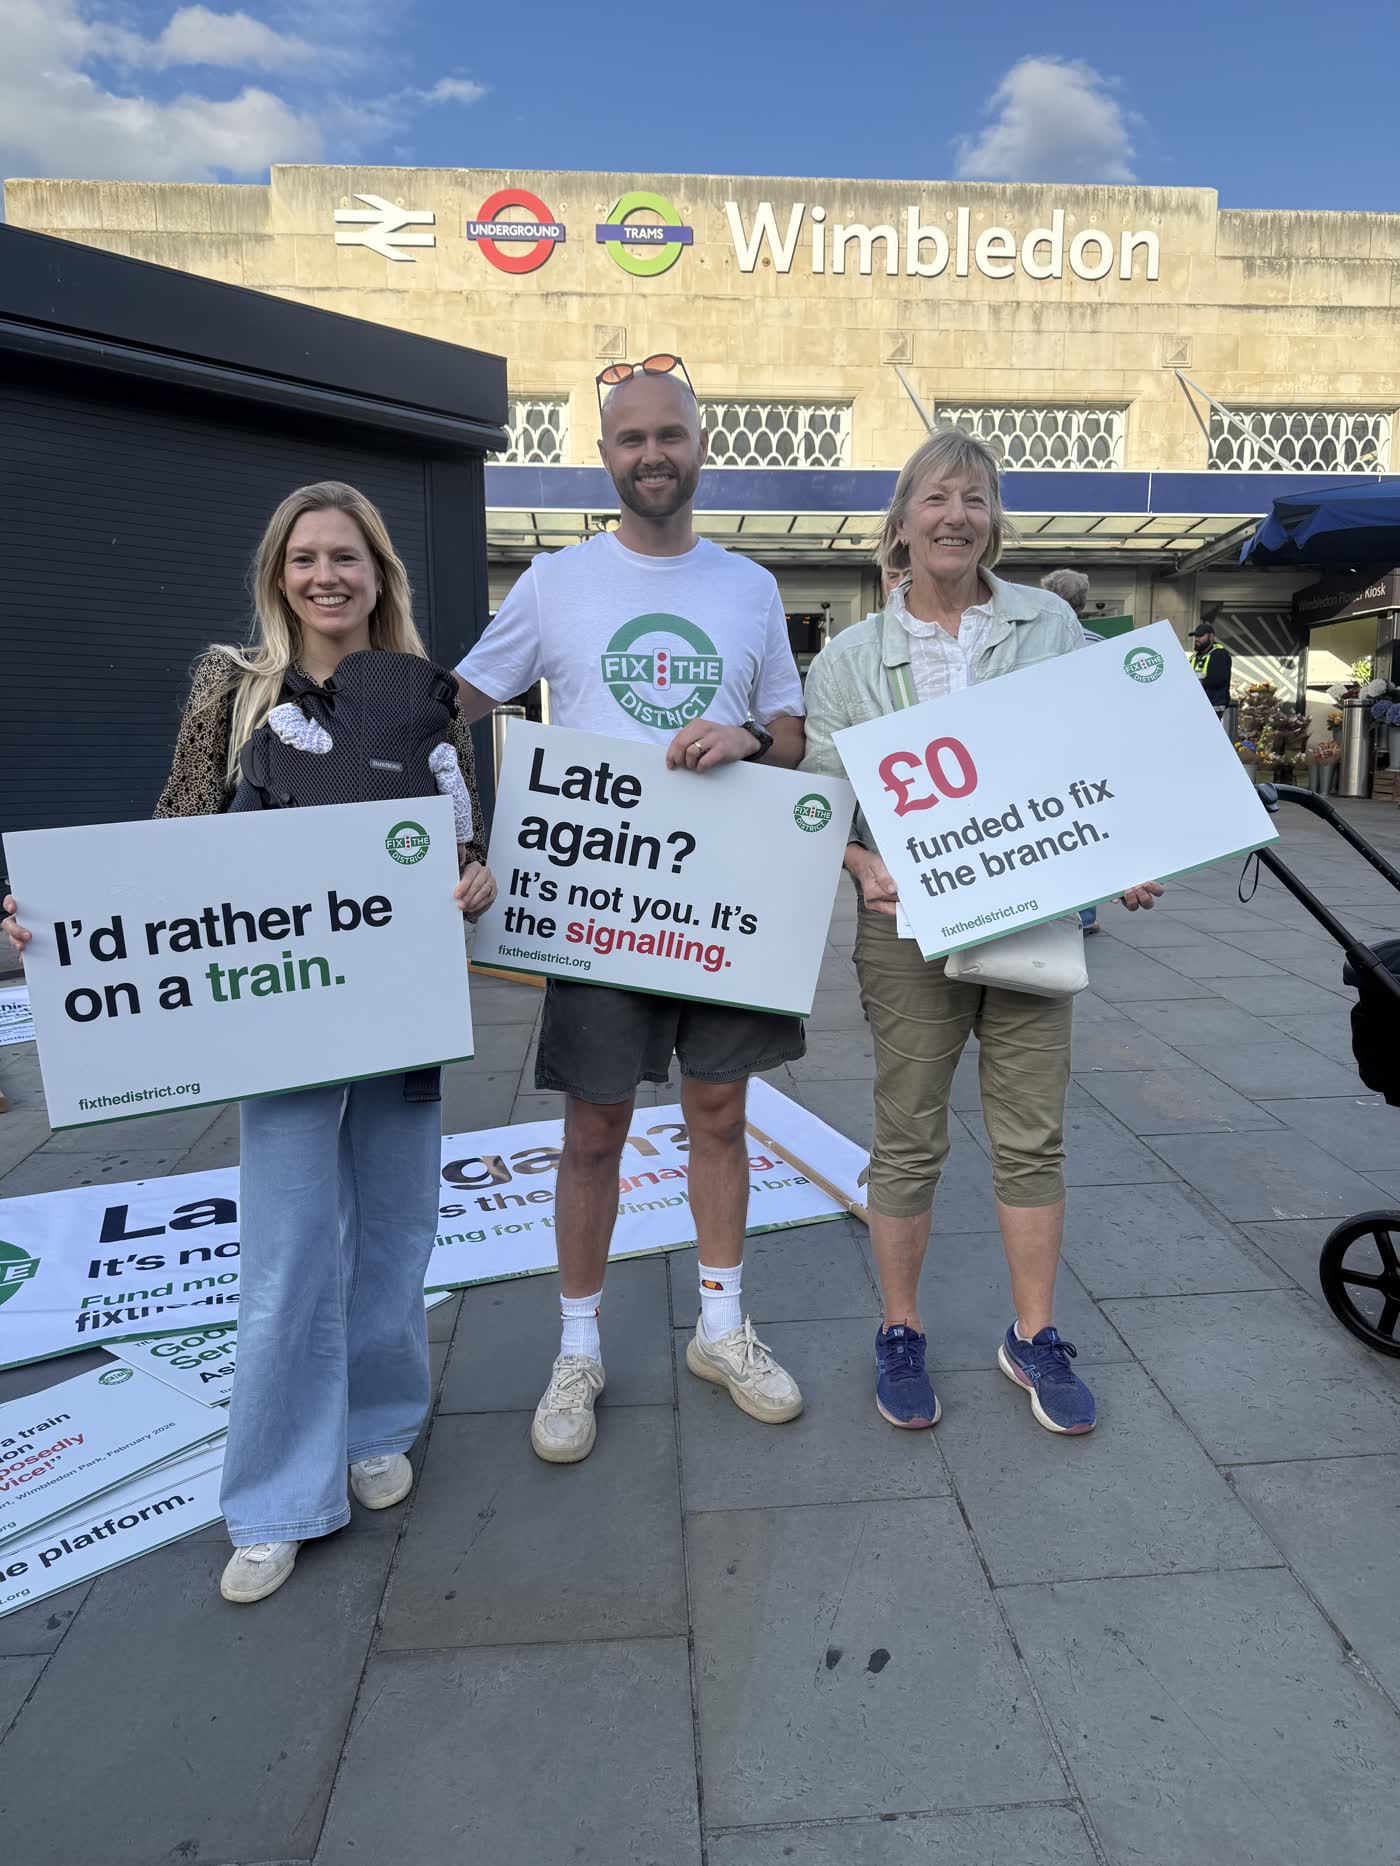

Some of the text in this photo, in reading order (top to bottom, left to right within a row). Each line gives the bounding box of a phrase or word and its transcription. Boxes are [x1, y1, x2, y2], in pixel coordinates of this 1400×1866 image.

[470, 225, 560, 237] UNDERGROUND
[624, 228, 664, 239] TRAMS
[724, 201, 1160, 280] Wimbledon
[1364, 582, 1386, 599] Kiosk
[604, 657, 720, 680] FIX THE
[1125, 656, 1162, 673] FIX THE
[1133, 666, 1161, 682] DISTRICT
[620, 690, 706, 727] DISTRICT
[528, 747, 642, 809] Late
[878, 736, 978, 817] £0
[794, 806, 831, 819] FIX THE
[796, 817, 825, 832] DISTRICT
[906, 777, 1115, 863] funded to fix
[386, 837, 430, 849] FIX THE
[391, 848, 426, 864] DISTRICT
[517, 816, 697, 874] again?
[920, 818, 1110, 897] the branch.
[509, 869, 758, 935] It's not you. It's
[941, 899, 1039, 938] fixthedistrict.org
[54, 890, 393, 966] I'd rather be
[504, 907, 732, 972] the signalling.
[498, 944, 591, 971] fixthedistrict.org
[64, 950, 346, 1023] on a train.
[78, 1081, 201, 1111] fixthedistrict.org
[88, 1254, 165, 1279] It's
[180, 1242, 240, 1265] no
[474, 1190, 555, 1212] the
[99, 1198, 237, 1243] La
[81, 1282, 173, 1309] Fund
[491, 1221, 534, 1236] for
[761, 1176, 810, 1190] bra
[150, 1328, 237, 1358] Goo
[200, 1361, 235, 1384] As
[0, 1413, 71, 1448] a train
[0, 1433, 84, 1481] posedly
[15, 1421, 176, 1500] Wimbledon Park, February 2026
[38, 1495, 195, 1569] platform.
